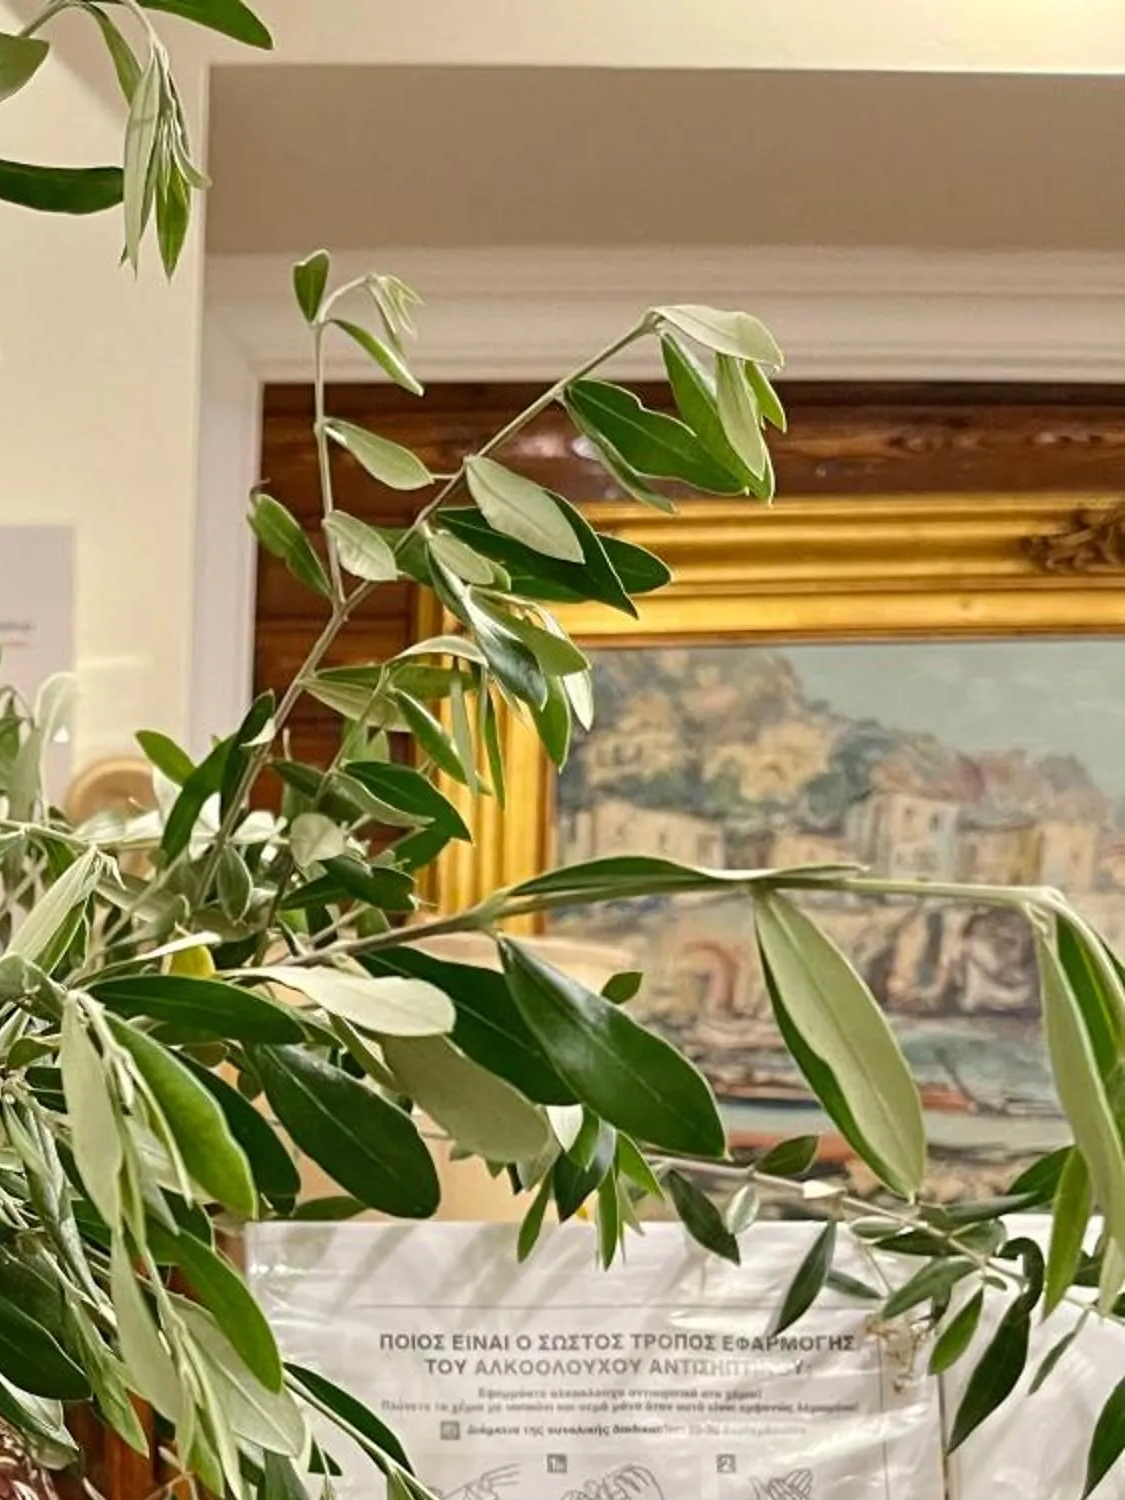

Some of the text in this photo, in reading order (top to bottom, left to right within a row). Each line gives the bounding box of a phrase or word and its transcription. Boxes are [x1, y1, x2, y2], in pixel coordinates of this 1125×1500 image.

[379, 1334, 856, 1352] ΠΟΙΟΣ ΕΙΝΑΙ Ο ΣΩΣΤΟΣ ΤΡΟΠΟΣ ΕΦΑΡΜΟΓΗΣ
[425, 1359, 467, 1375] ΤΟΥ
[474, 1359, 642, 1376] ΑΛΚΟΟΛΟΥΧΟΥ
